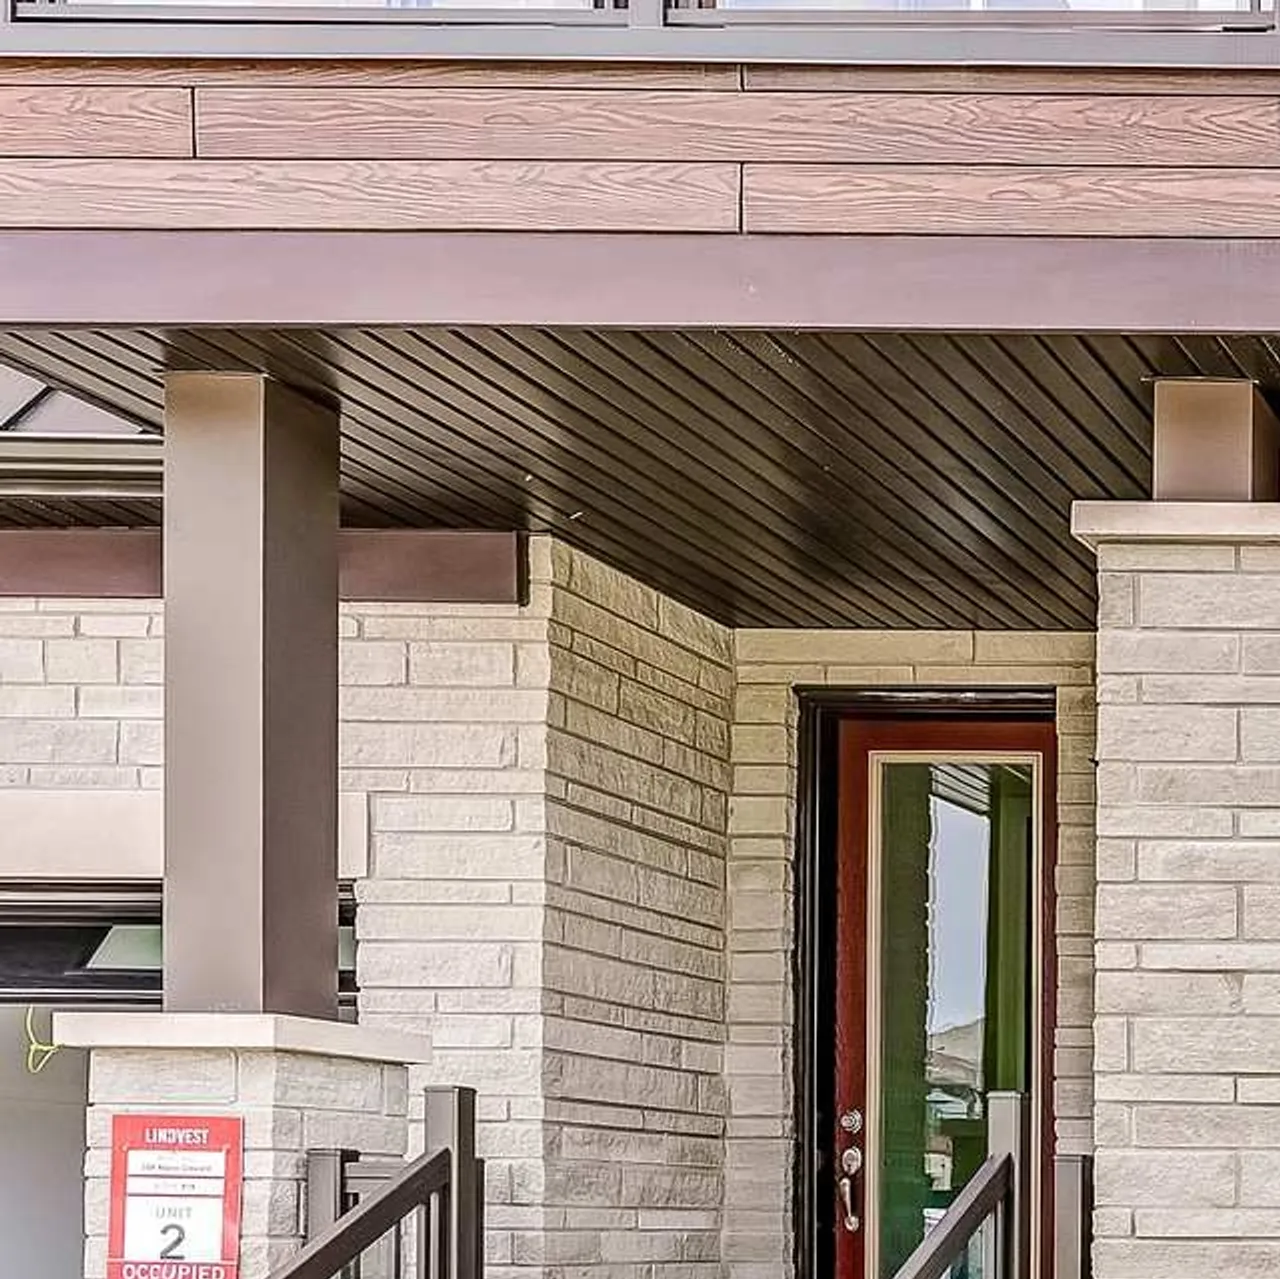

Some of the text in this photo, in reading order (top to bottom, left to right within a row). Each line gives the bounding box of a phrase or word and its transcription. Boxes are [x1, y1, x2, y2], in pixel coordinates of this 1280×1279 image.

[145, 1128, 209, 1144] LINDVEST
[156, 1206, 193, 1219] UNIT
[160, 1224, 186, 1260] 2
